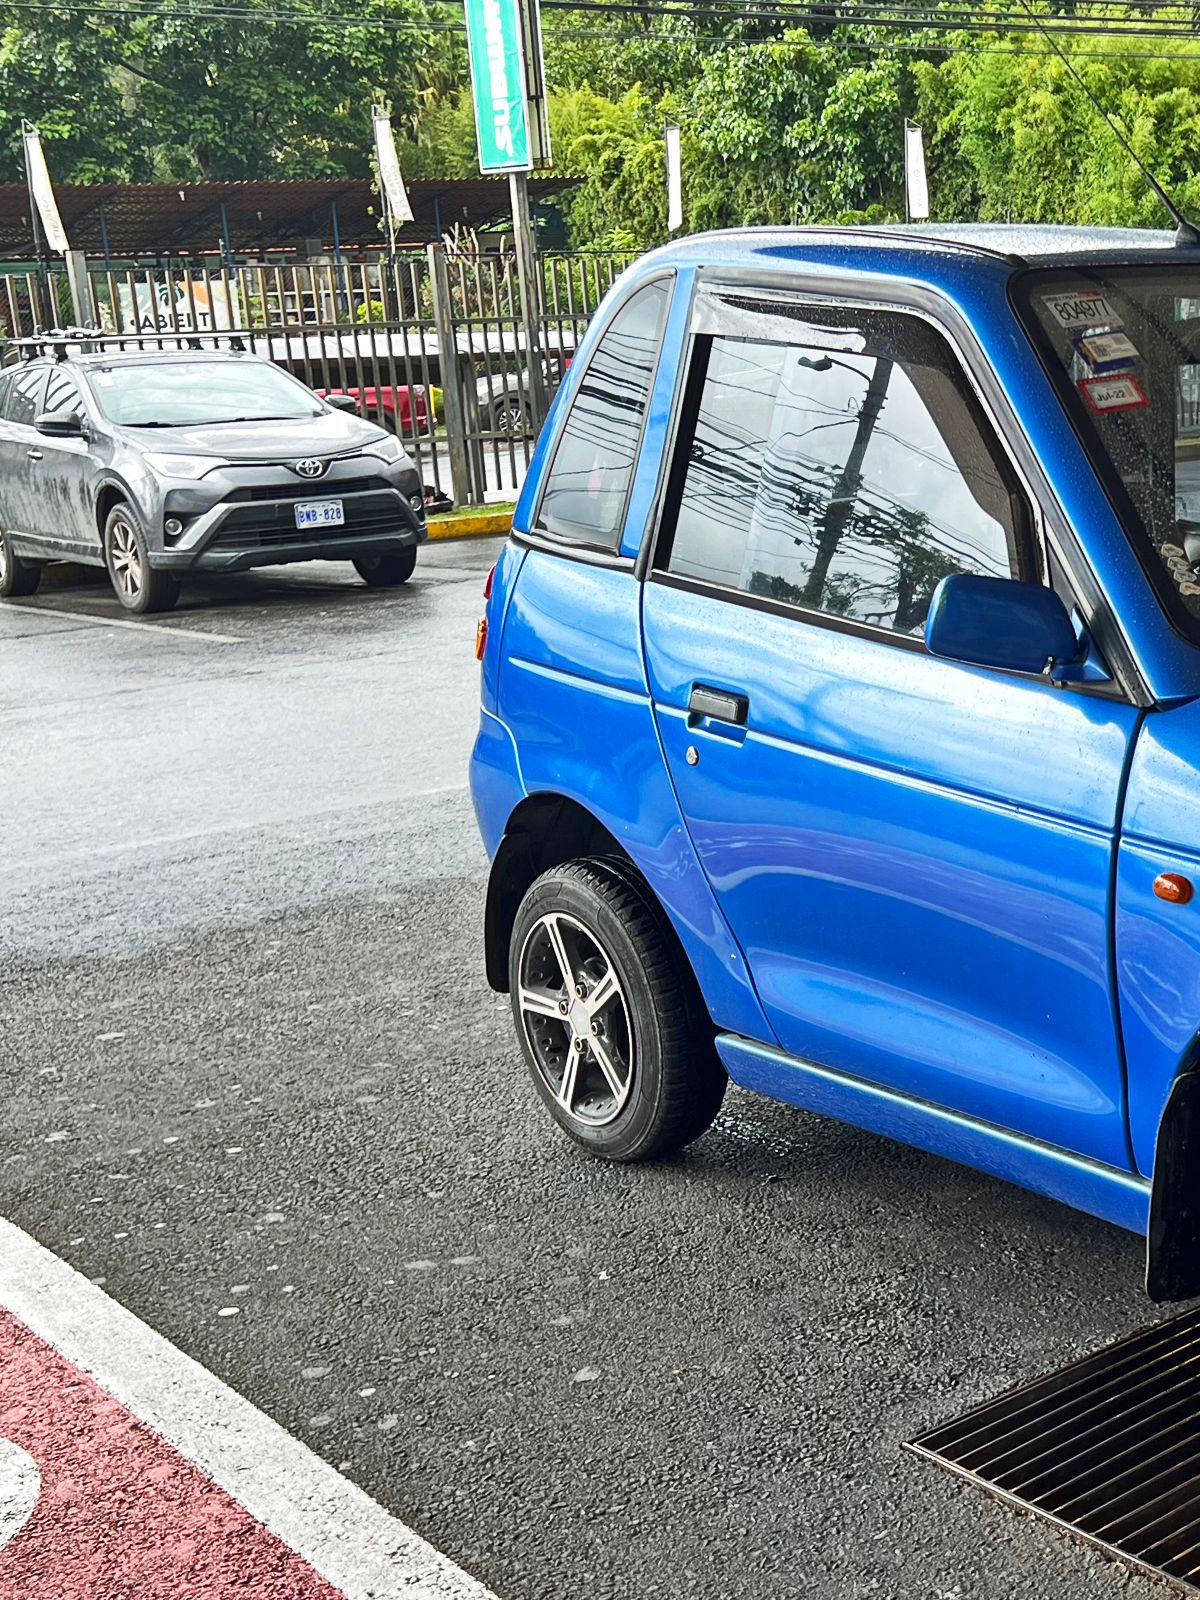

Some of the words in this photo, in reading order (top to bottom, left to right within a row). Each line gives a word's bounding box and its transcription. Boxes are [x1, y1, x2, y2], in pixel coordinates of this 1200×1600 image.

[483, 0, 514, 157] SUBWA
[1053, 299, 1110, 321] 804977
[1097, 390, 1126, 402] Jul-22
